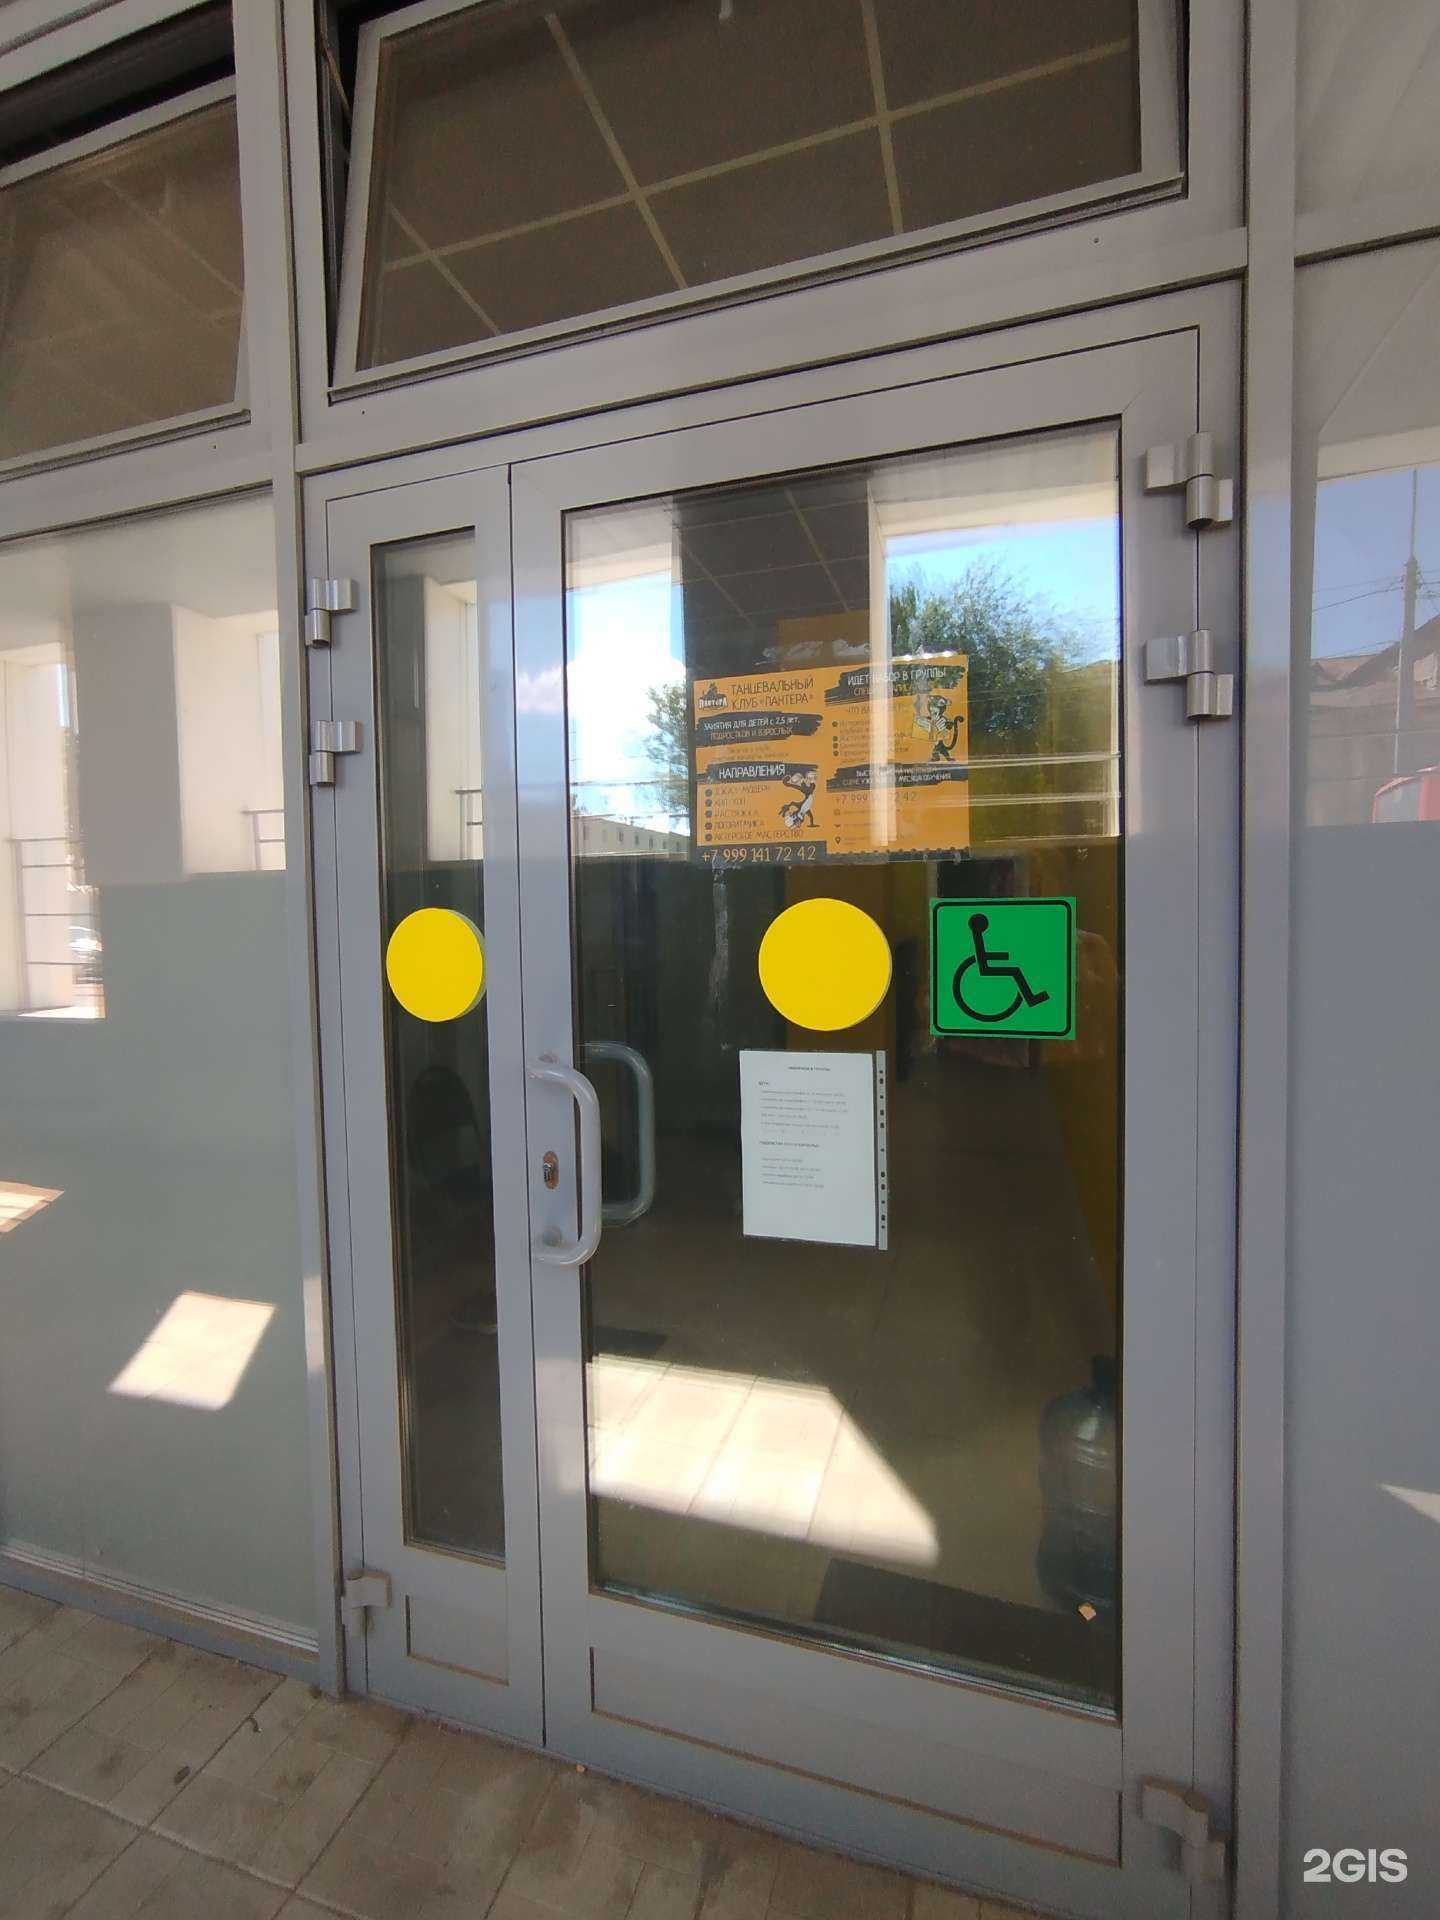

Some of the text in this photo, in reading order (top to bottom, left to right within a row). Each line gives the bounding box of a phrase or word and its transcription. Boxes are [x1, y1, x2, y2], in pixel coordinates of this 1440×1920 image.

[910, 666, 946, 679] ГРУППЫ
[730, 676, 815, 696] ТАНЦЕВАЛЬНЫЙ
[731, 699, 759, 710] КЛУБ
[719, 763, 786, 779] НАПРАВЛЕНИЯ
[723, 848, 748, 863] 999
[751, 847, 771, 863] 141
[775, 846, 792, 862] 72
[797, 845, 816, 861] 42
